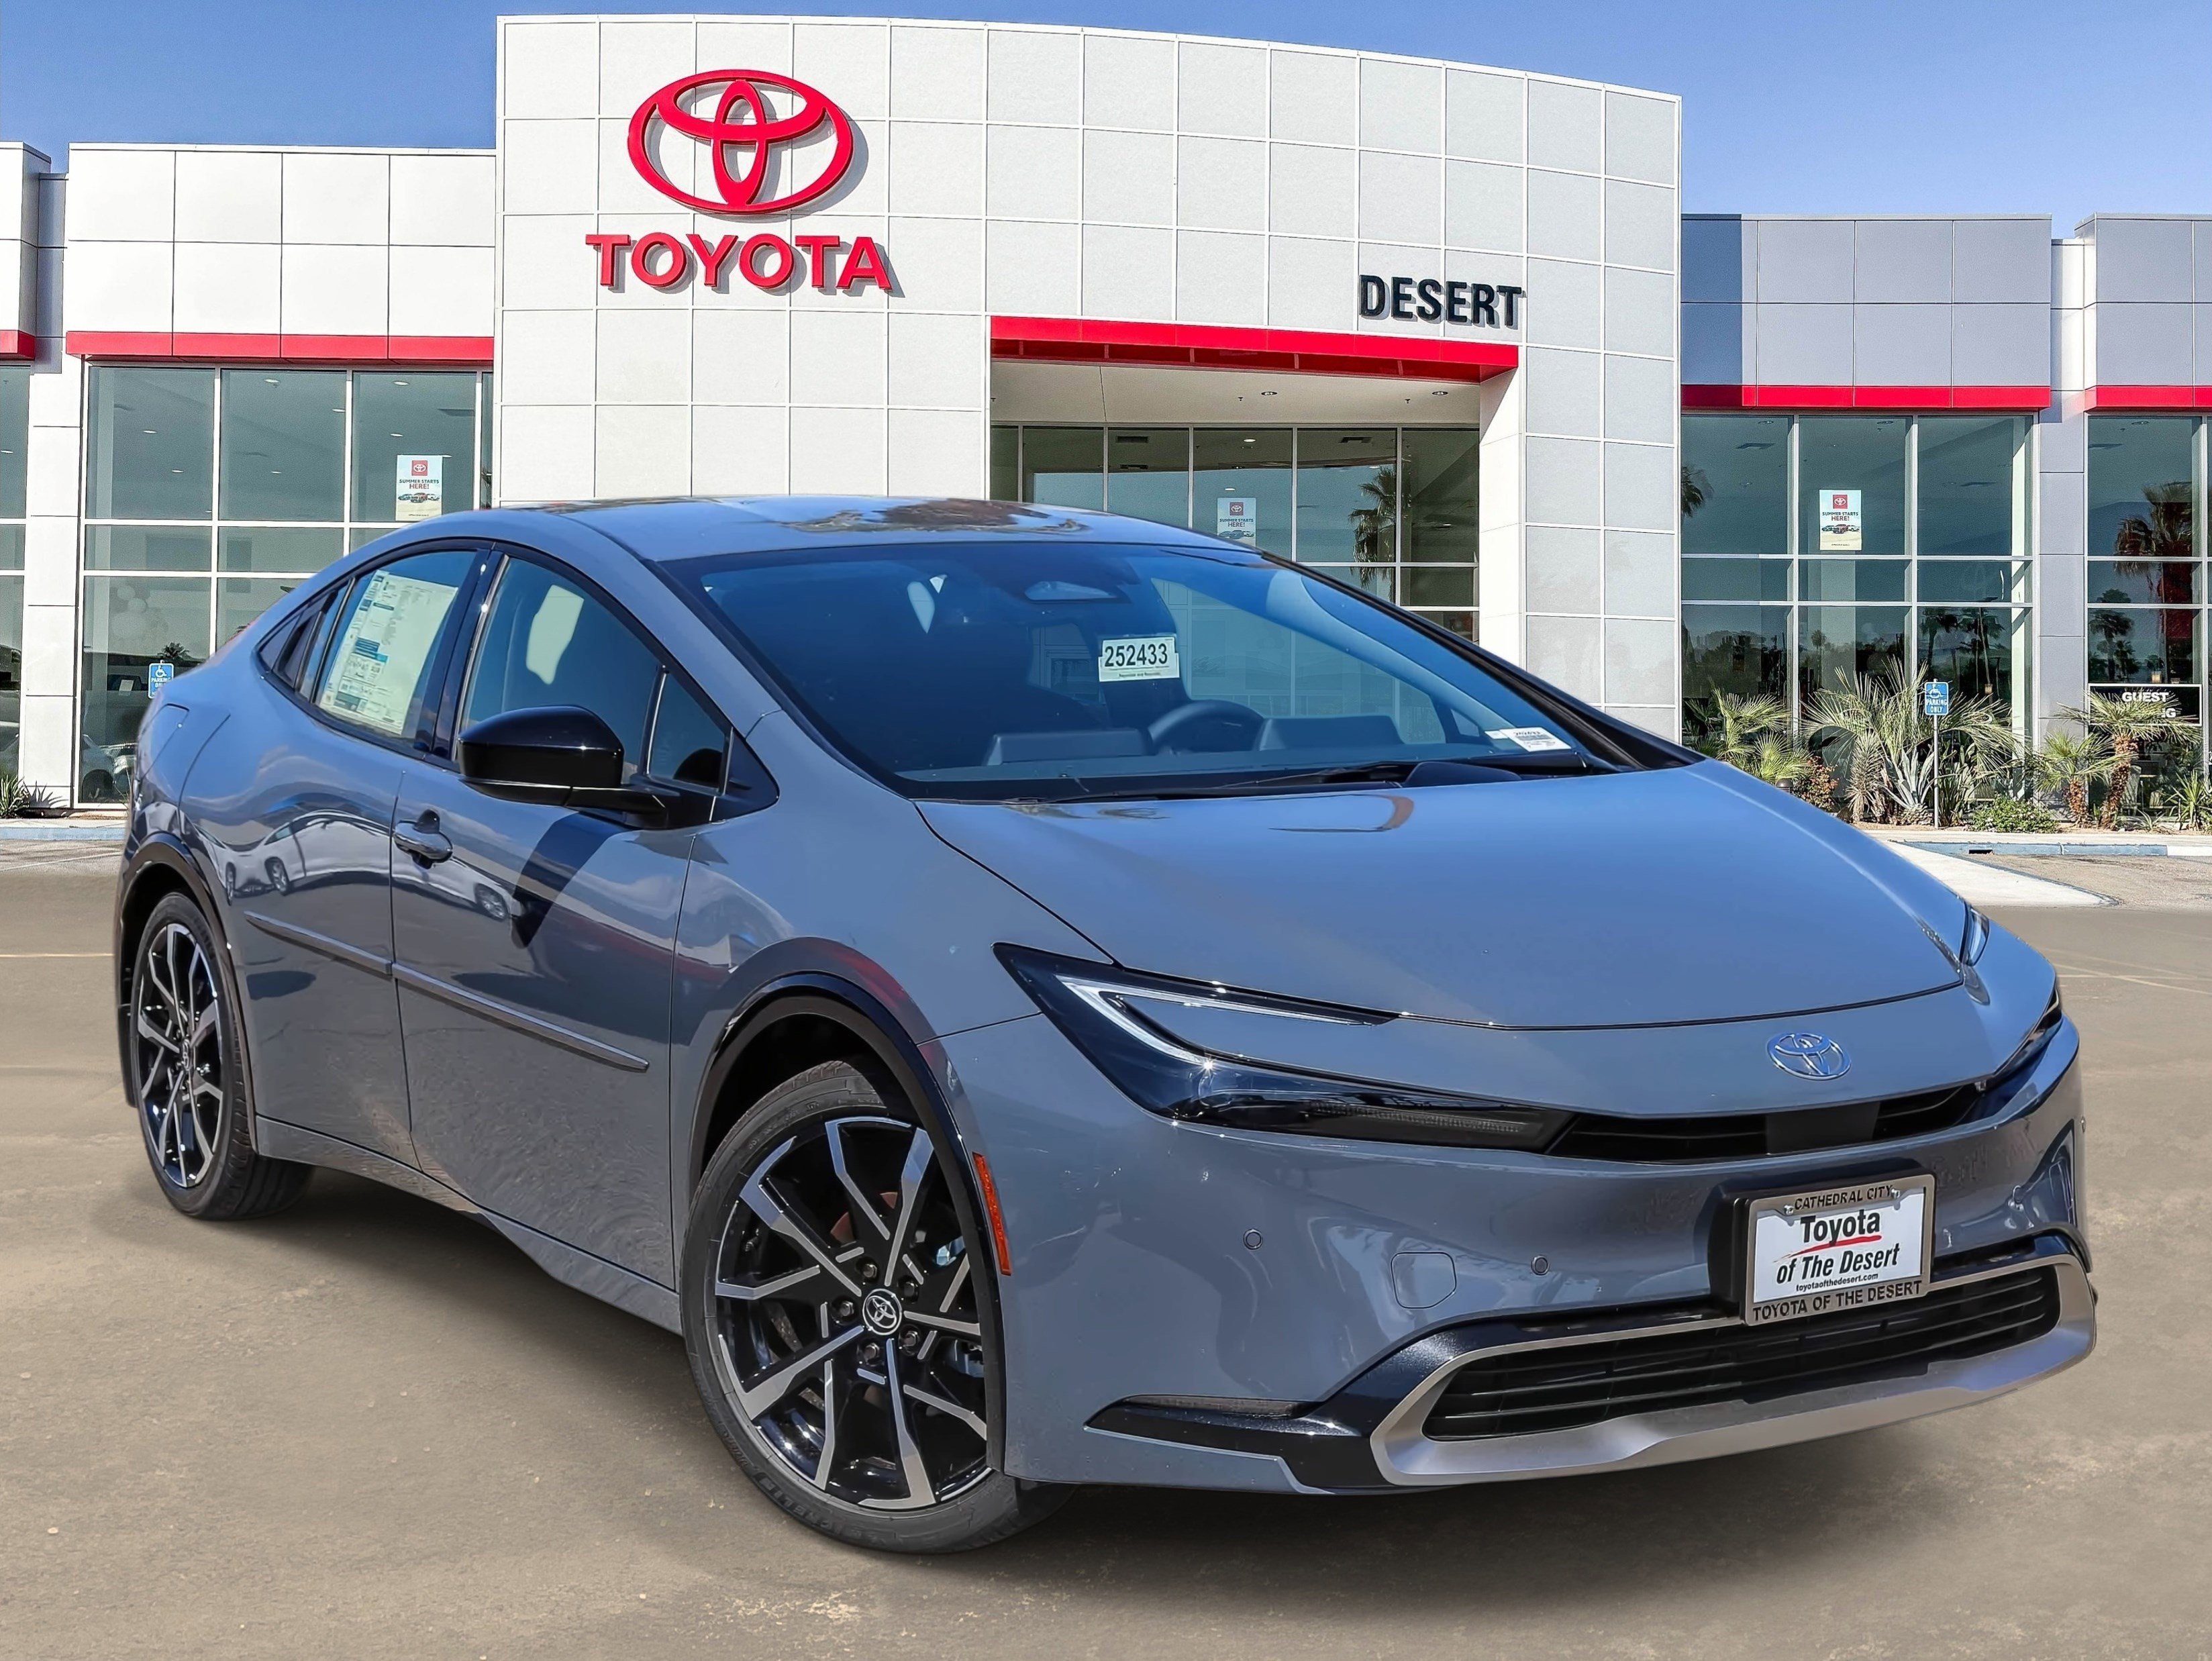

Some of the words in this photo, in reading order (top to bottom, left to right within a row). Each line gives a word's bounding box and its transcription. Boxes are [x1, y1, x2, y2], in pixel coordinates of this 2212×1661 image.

[585, 232, 893, 291] TOYOTA
[1359, 274, 1522, 327] DESERT
[1105, 644, 1168, 666] 252433
[2121, 692, 2169, 703] GUEST
[1794, 1189, 1864, 1210] CATHEDRAL
[1866, 1185, 1893, 1200] CITY
[1800, 1209, 1880, 1247] Toyota
[1776, 1258, 1797, 1284] of
[1801, 1256, 1833, 1280] The
[1839, 1243, 1900, 1274] Desert
[1796, 1273, 1878, 1292] toyotaofthedesert.com
[1753, 1299, 1808, 1321] TOYOTA
[1812, 1295, 1831, 1311] OF
[1836, 1288, 1864, 1307] THE
[1867, 1280, 1922, 1303] DESERT
